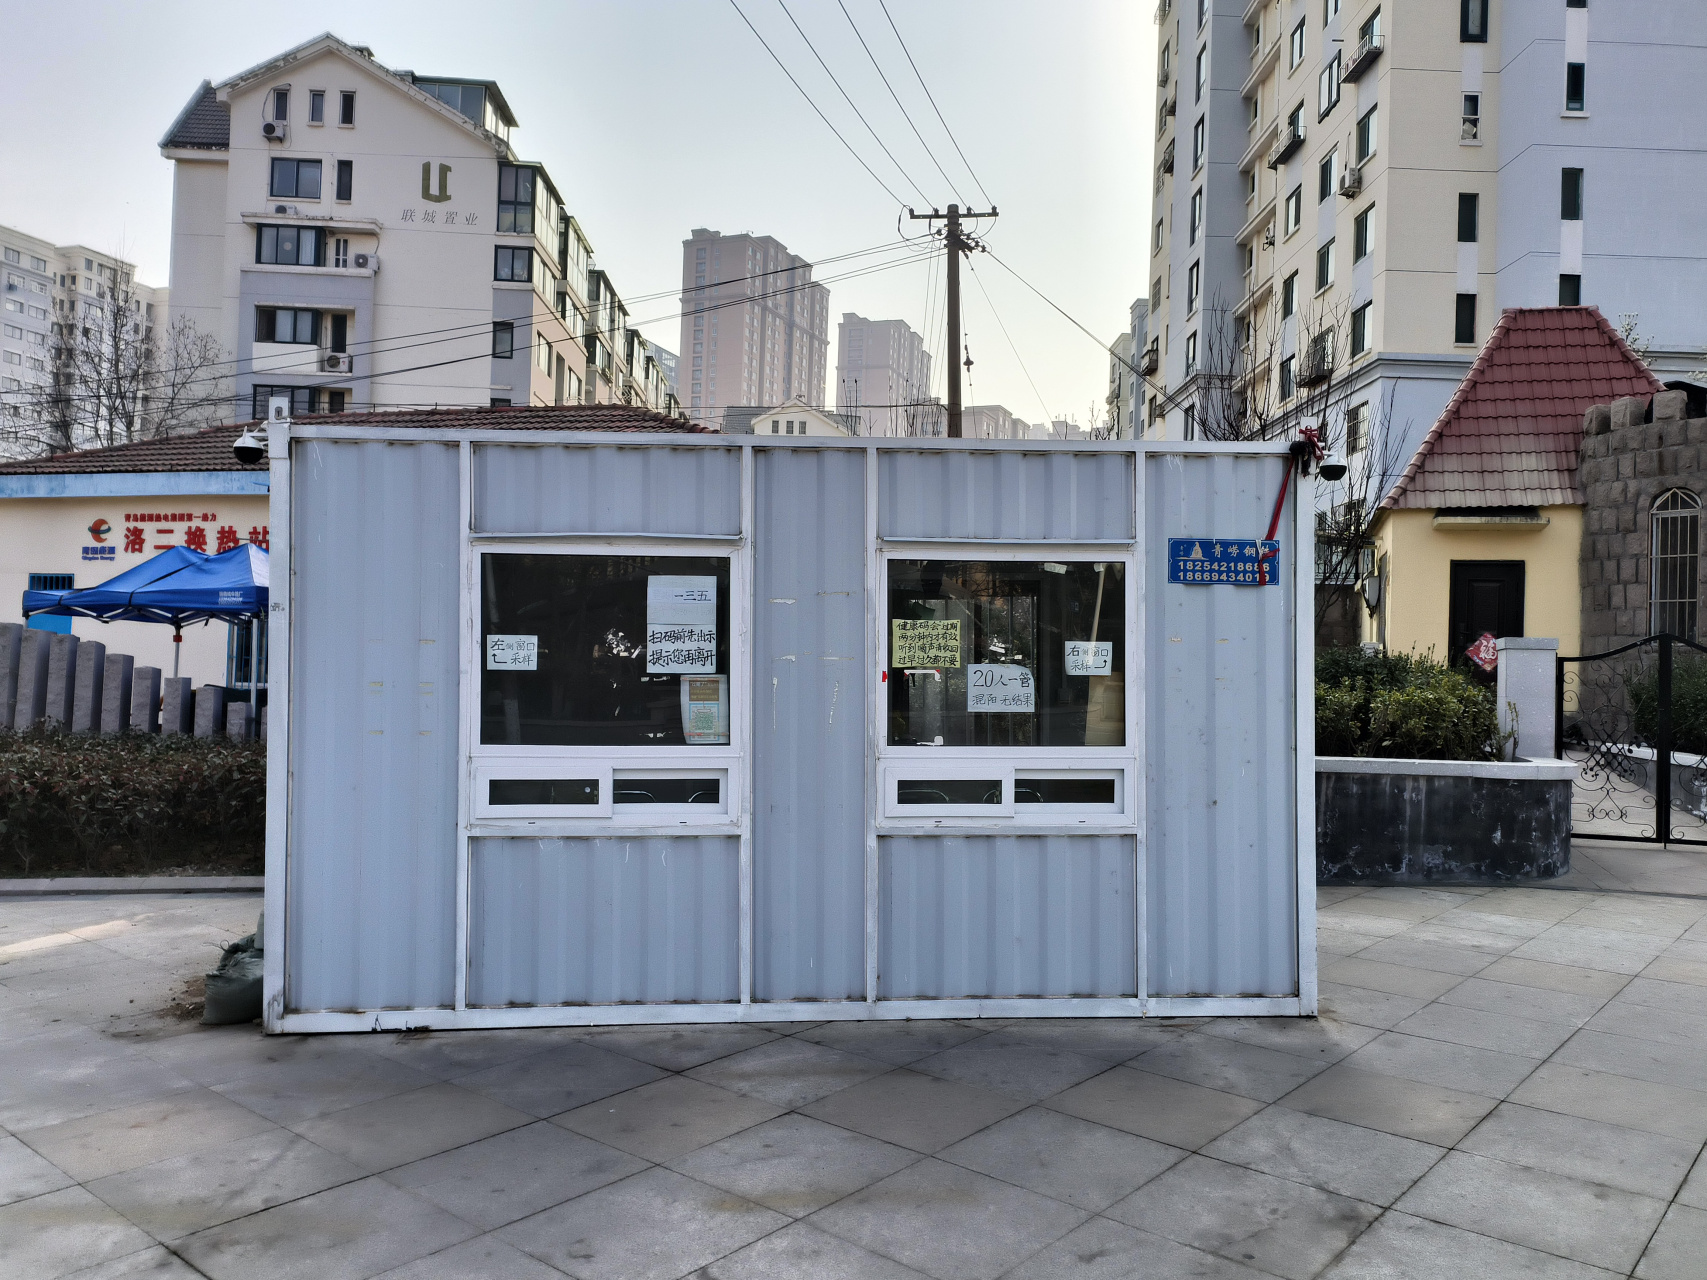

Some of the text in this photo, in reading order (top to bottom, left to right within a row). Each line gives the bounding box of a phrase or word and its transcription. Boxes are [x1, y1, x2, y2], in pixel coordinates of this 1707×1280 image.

[401, 208, 478, 226] 联城置业
[674, 590, 712, 602] 一三五
[648, 628, 716, 645] 扫码前先出示
[898, 631, 959, 643] 两分钟内才有效
[490, 637, 536, 652] 左侧窗口
[1066, 645, 1109, 658] 右侧窗口
[510, 651, 534, 667] 采样
[648, 646, 716, 667] 提示您再离开
[897, 654, 960, 667] 过早过久都不要
[1070, 659, 1091, 673] 采样
[973, 669, 1032, 689] 20人一管
